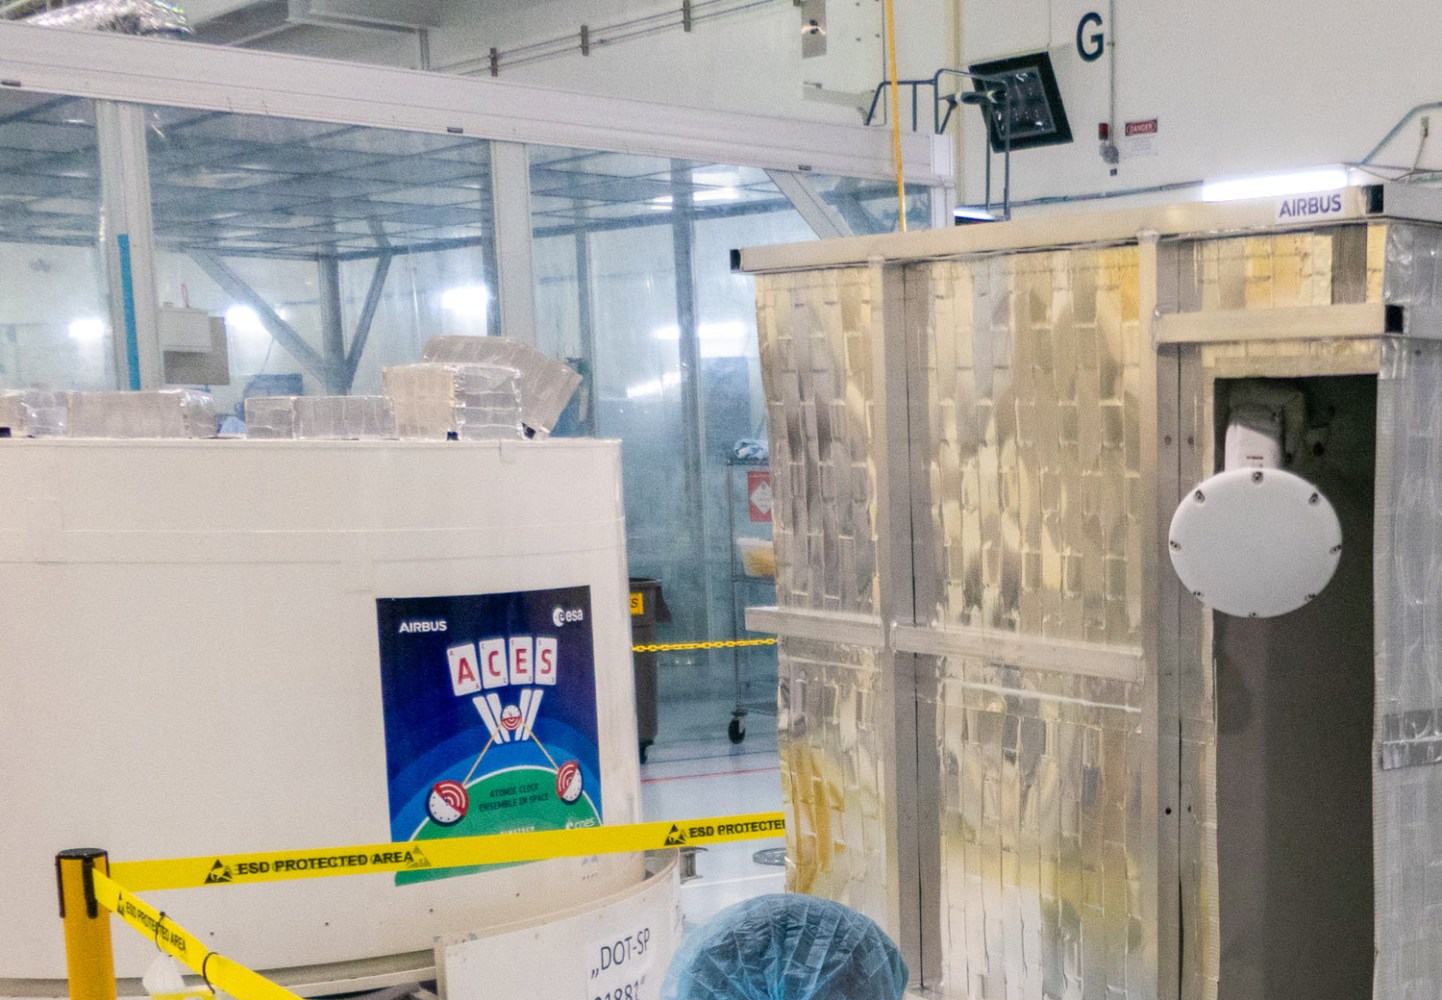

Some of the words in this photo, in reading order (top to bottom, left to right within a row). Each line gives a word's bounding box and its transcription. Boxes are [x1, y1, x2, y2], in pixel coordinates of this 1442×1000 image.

[1076, 12, 1104, 63] G
[1129, 123, 1153, 134] DANGER
[1279, 194, 1342, 218] AIRBUS
[399, 620, 447, 633] AIRBUS
[457, 648, 553, 685] ACES
[490, 787, 517, 798] ATOMIC
[519, 783, 540, 793] CLOCK
[479, 799, 517, 812] ENSEMBLE
[519, 796, 528, 806] IN
[529, 793, 549, 803] SPACE
[689, 826, 714, 838] ESD
[238, 861, 270, 875] ESD
[274, 854, 368, 872] PROTECTED
[372, 851, 414, 865] AREA
[126, 901, 137, 919] ESD
[170, 932, 187, 954] AREA
